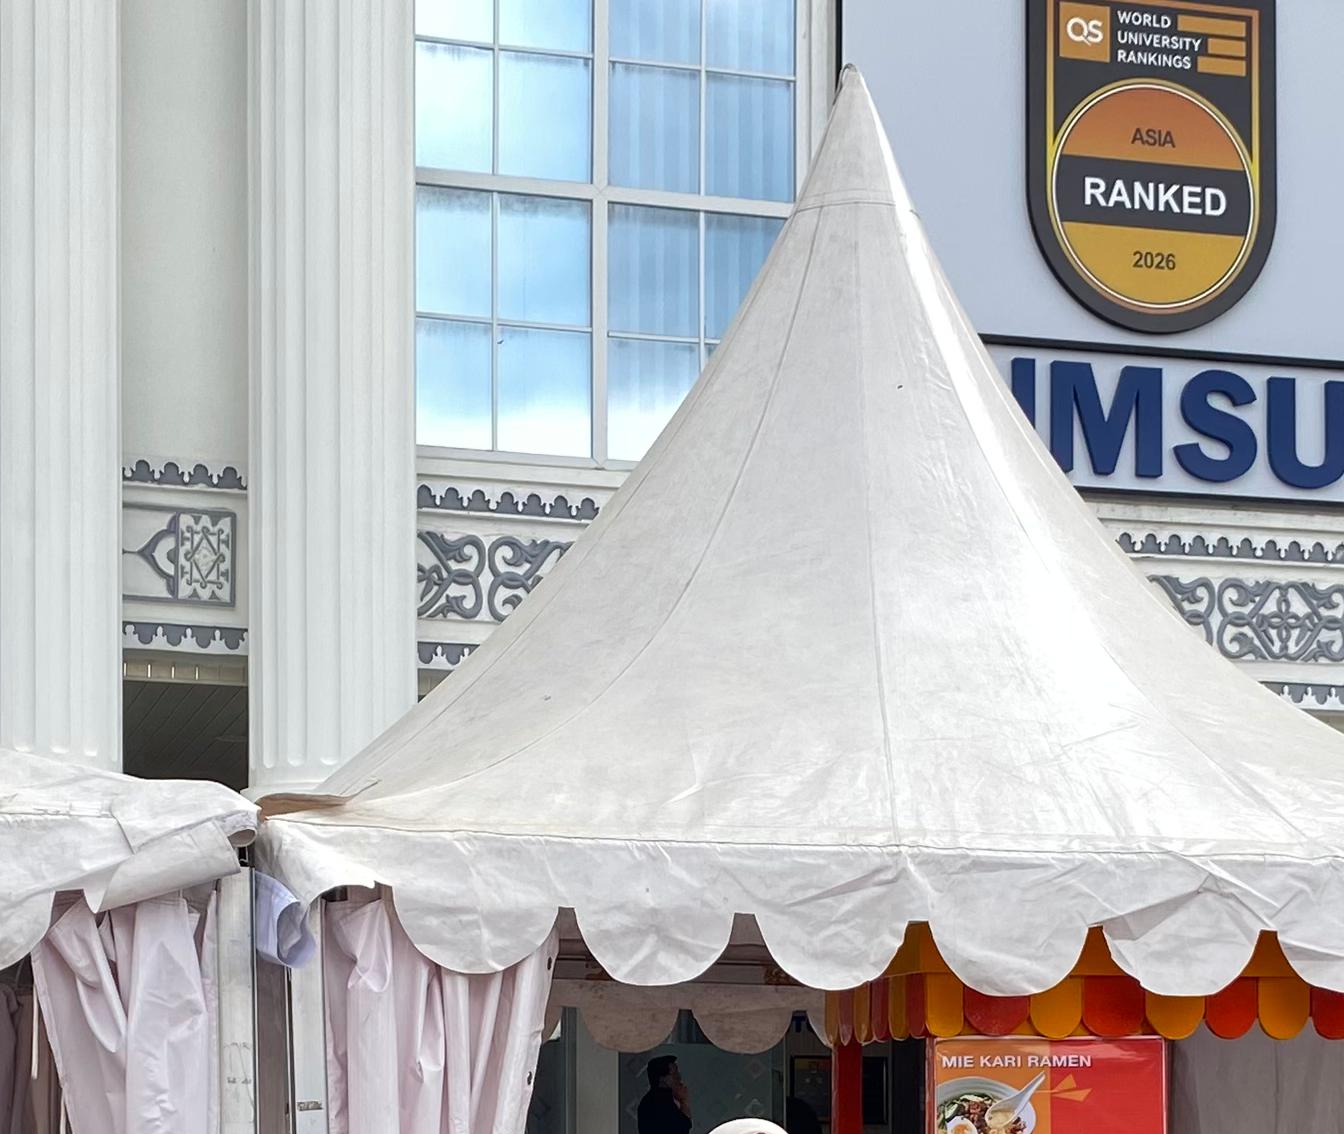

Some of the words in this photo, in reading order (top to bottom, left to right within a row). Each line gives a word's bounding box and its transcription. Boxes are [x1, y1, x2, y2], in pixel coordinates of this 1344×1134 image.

[1117, 10, 1171, 29] WORLD
[1066, 17, 1104, 46] QS
[1117, 30, 1202, 52] UNIVERSITY
[1117, 50, 1192, 70] RANKINGS
[1131, 127, 1176, 148] ASIA
[1084, 176, 1227, 217] RANKED
[1132, 250, 1176, 272] 2026
[942, 1055, 975, 1069] MIE
[979, 1055, 1021, 1068] KARI
[1027, 1054, 1092, 1068] RAMEN
